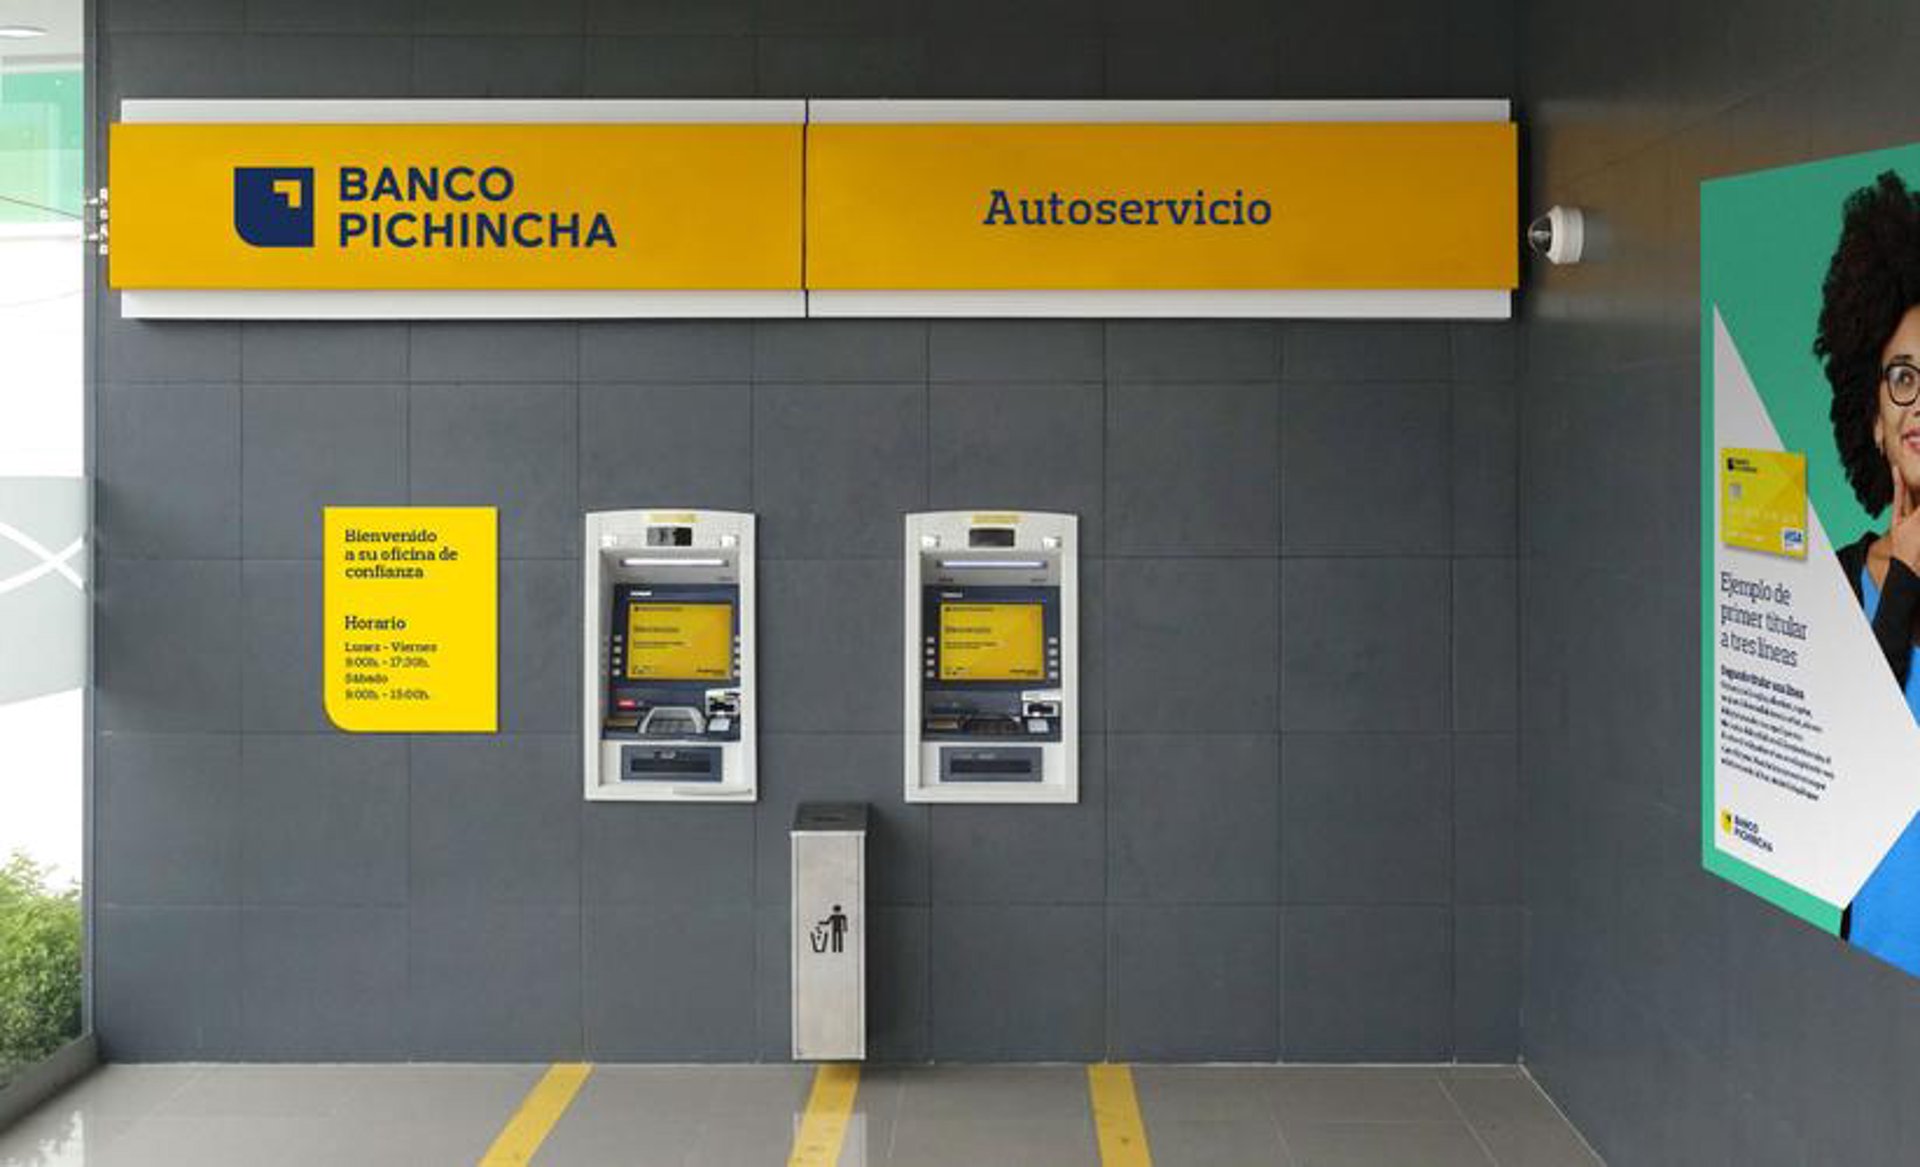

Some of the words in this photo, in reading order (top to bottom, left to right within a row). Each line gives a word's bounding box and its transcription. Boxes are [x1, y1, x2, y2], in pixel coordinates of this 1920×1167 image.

[340, 166, 514, 202] BANCO
[982, 189, 1271, 225] Autoservicio
[340, 213, 617, 248] PICHINCHA
[345, 529, 438, 542] Bienvenido
[345, 551, 355, 561] a
[359, 551, 378, 561] su
[381, 547, 435, 561] oficina
[439, 547, 458, 561] de
[345, 564, 424, 578] confianza
[1721, 571, 1771, 603] Ejemplo
[1775, 583, 1791, 606] de
[345, 615, 406, 630] Horario
[1721, 603, 1762, 628] primer
[1766, 611, 1807, 640] titular
[345, 642, 381, 652] Lunes
[391, 641, 438, 652] Viernes
[1721, 632, 1729, 647] a
[1730, 631, 1757, 655] tres
[1734, 814, 1759, 834] BANCO
